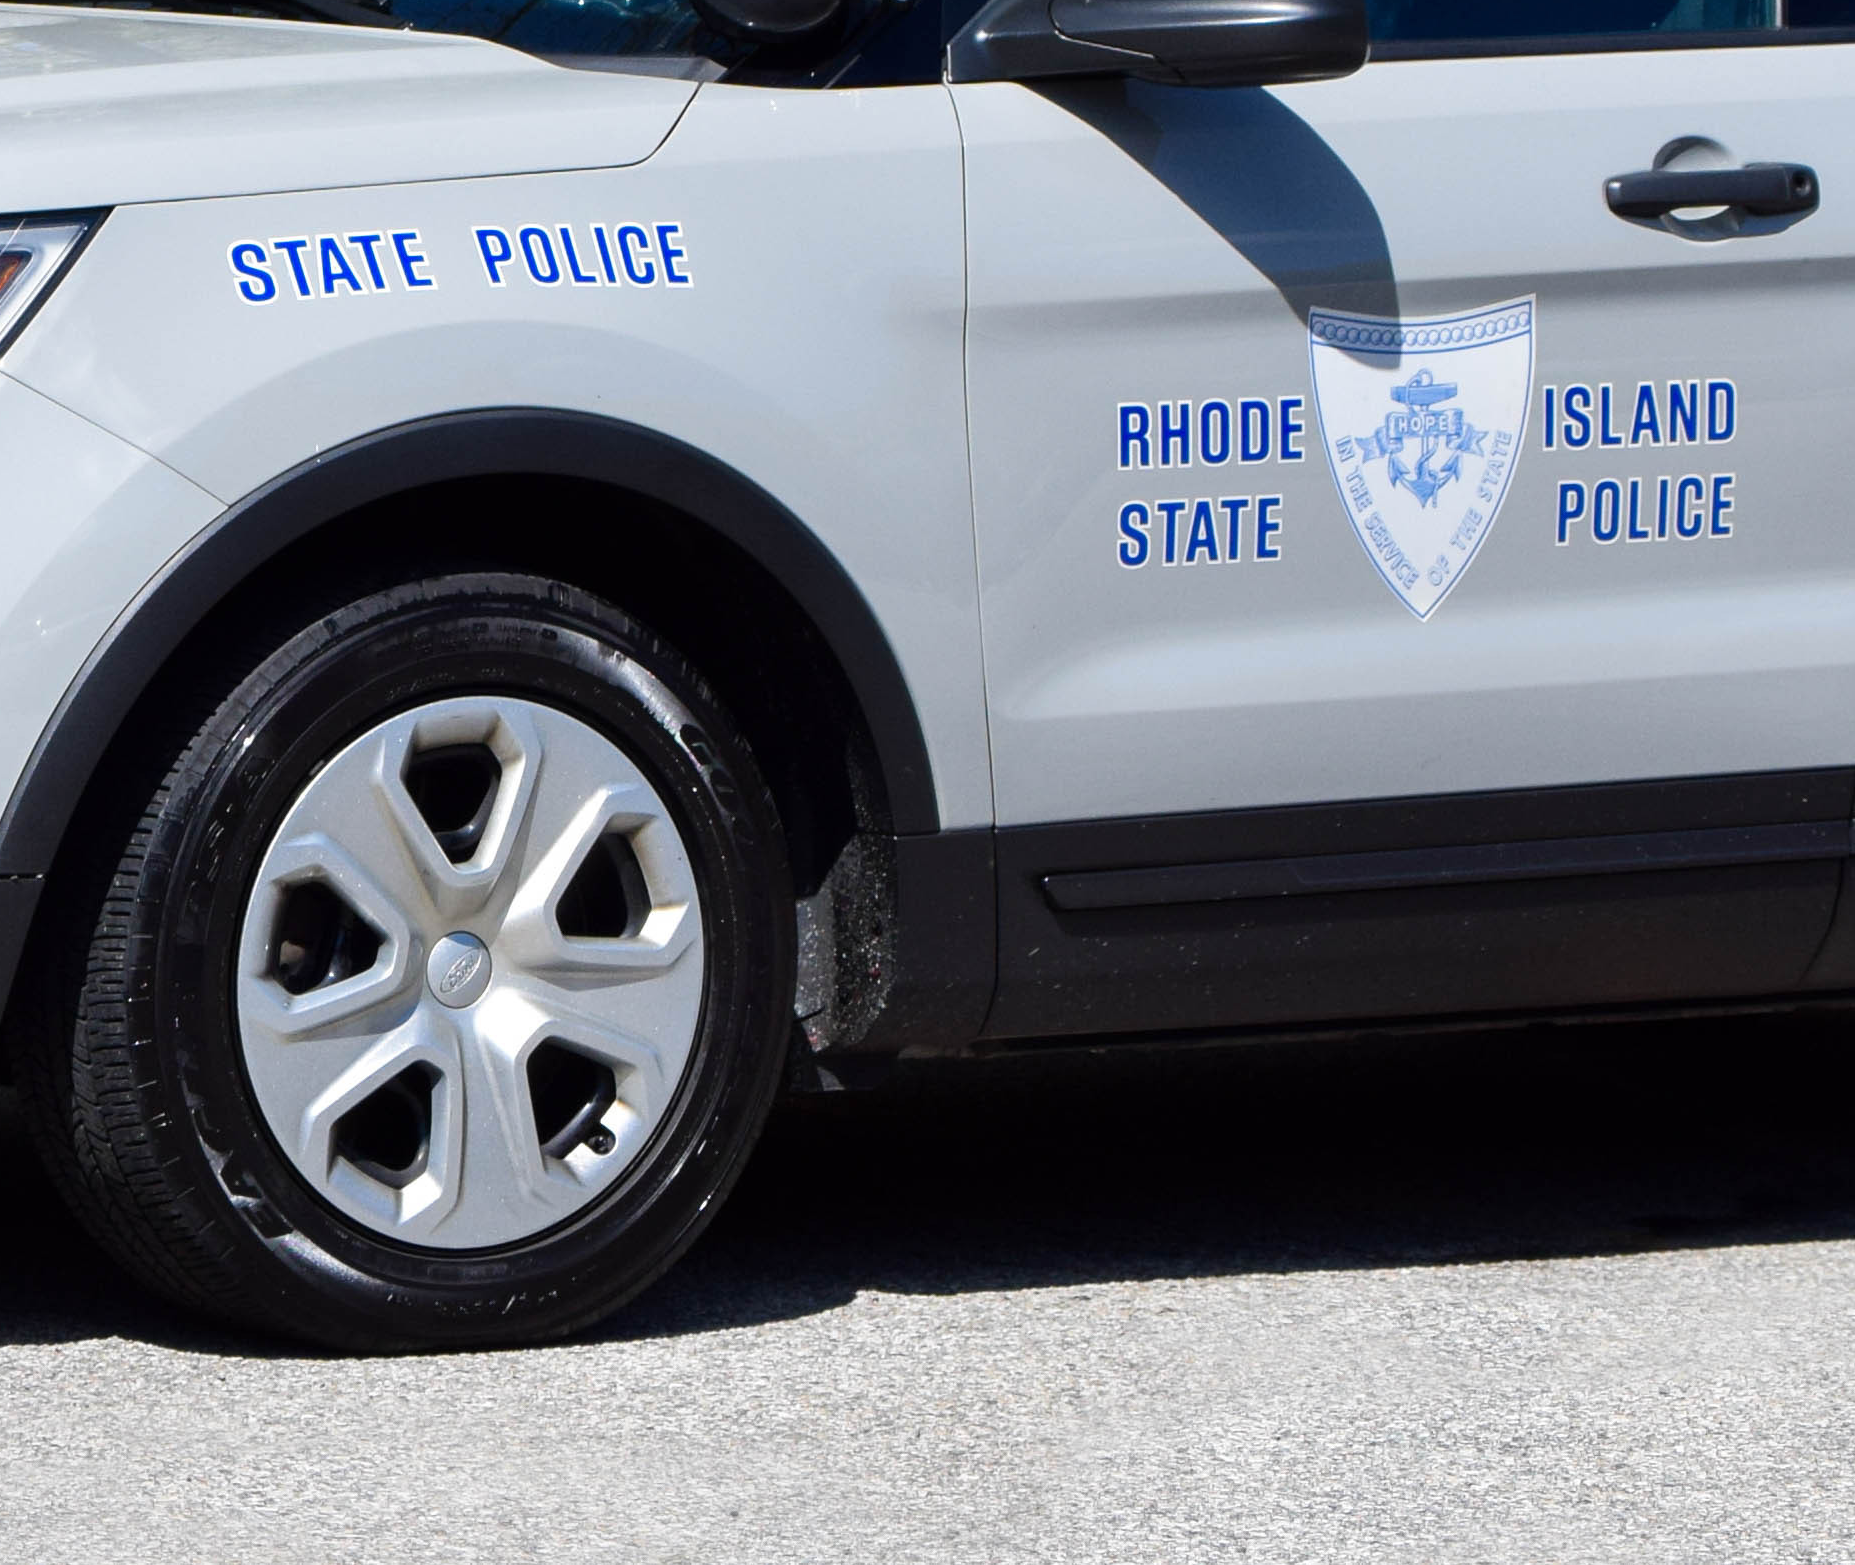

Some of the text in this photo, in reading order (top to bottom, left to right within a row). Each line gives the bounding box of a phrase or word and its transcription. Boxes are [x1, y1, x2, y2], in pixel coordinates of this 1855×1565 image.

[227, 222, 695, 306] STATE POLICE
[1117, 378, 1737, 470] RHODE ISLAND
[1397, 414, 1448, 433] HOPE
[1117, 473, 1736, 569] STATE POLICE
[1335, 431, 1512, 591] IN THE SERVICE OF THE STATE
